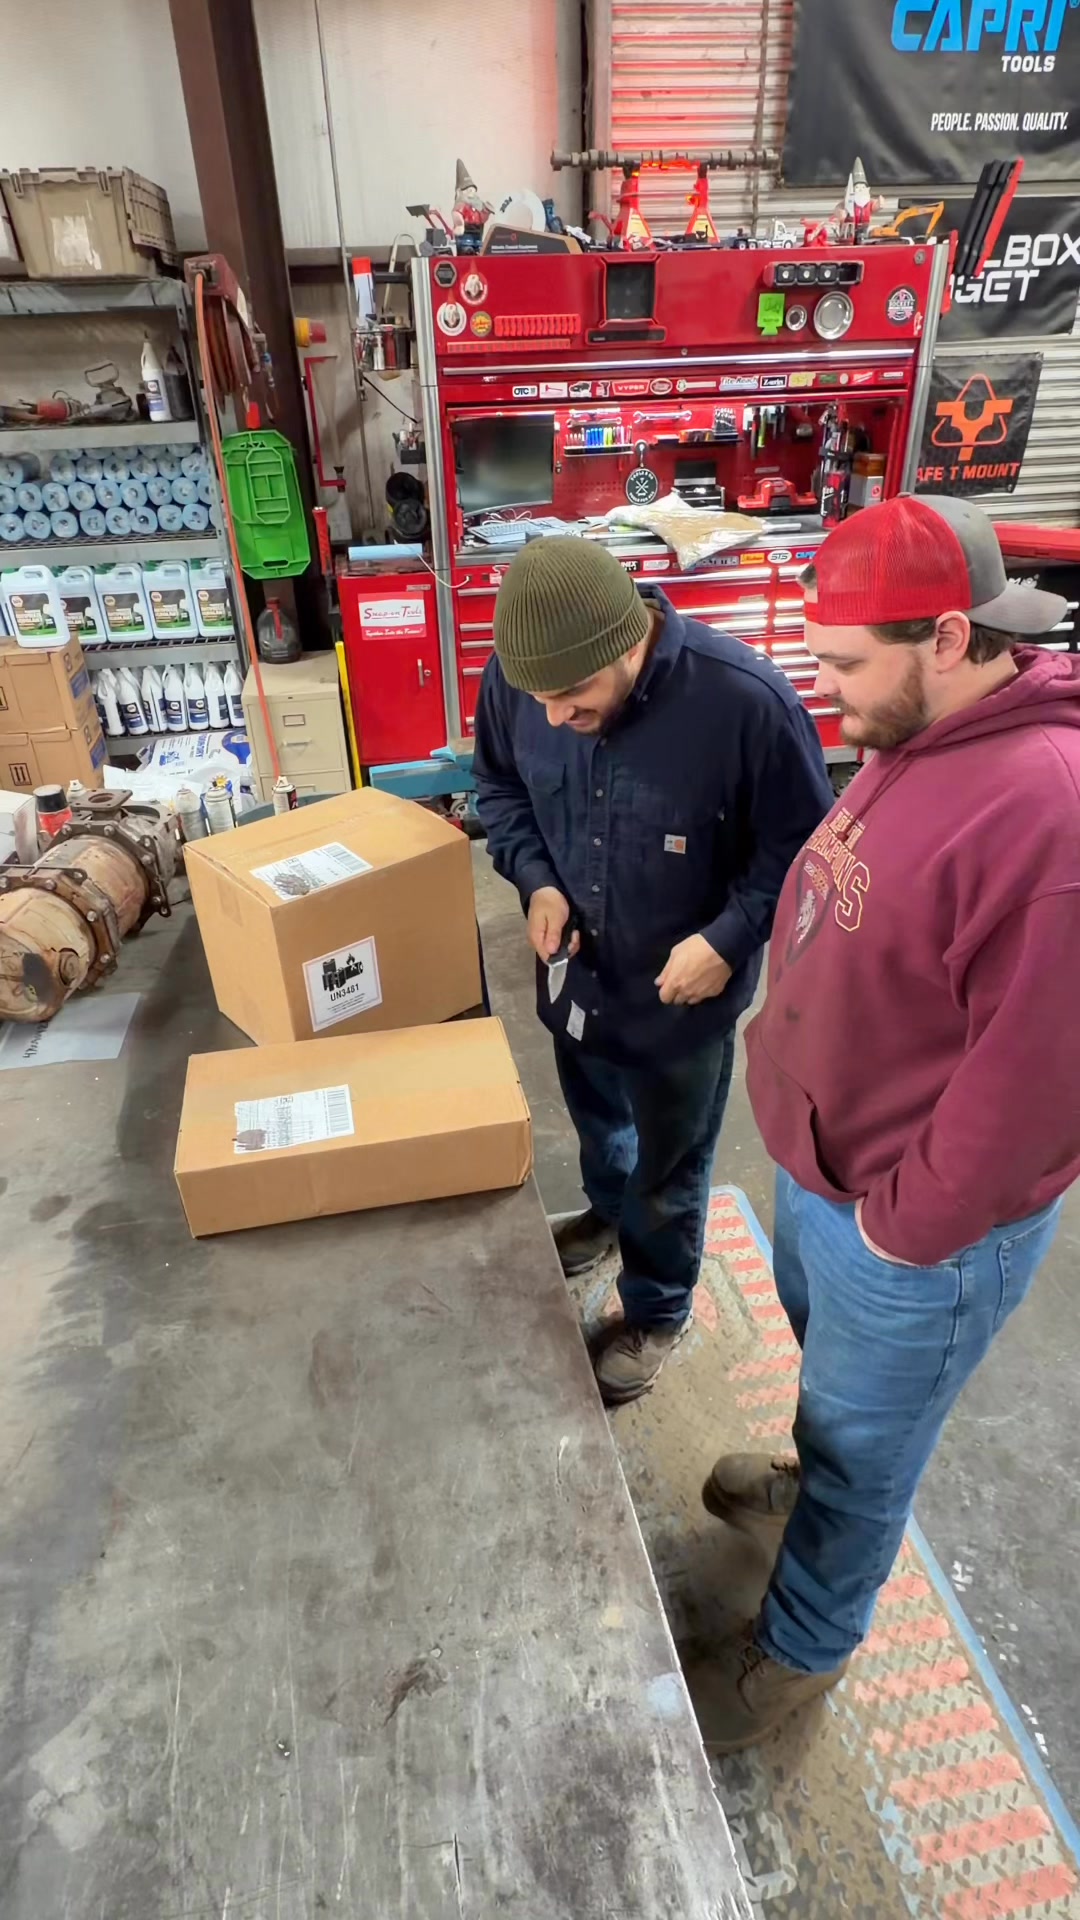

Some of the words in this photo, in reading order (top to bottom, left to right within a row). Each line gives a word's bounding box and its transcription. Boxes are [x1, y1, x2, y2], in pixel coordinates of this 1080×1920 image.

[890, 0, 1067, 52] CAPRI
[1001, 55, 1056, 73] TOOLS
[930, 112, 972, 132] PEOPLE.
[974, 112, 1020, 132] PASSION.
[1022, 111, 1069, 132] QUALITY.
[983, 233, 1080, 268] BOX
[950, 269, 1040, 303] GET
[513, 387, 530, 396] OTC
[916, 467, 944, 482] AFE
[950, 466, 960, 481] T
[963, 462, 1020, 480] MOUNT
[770, 552, 789, 561] STS
